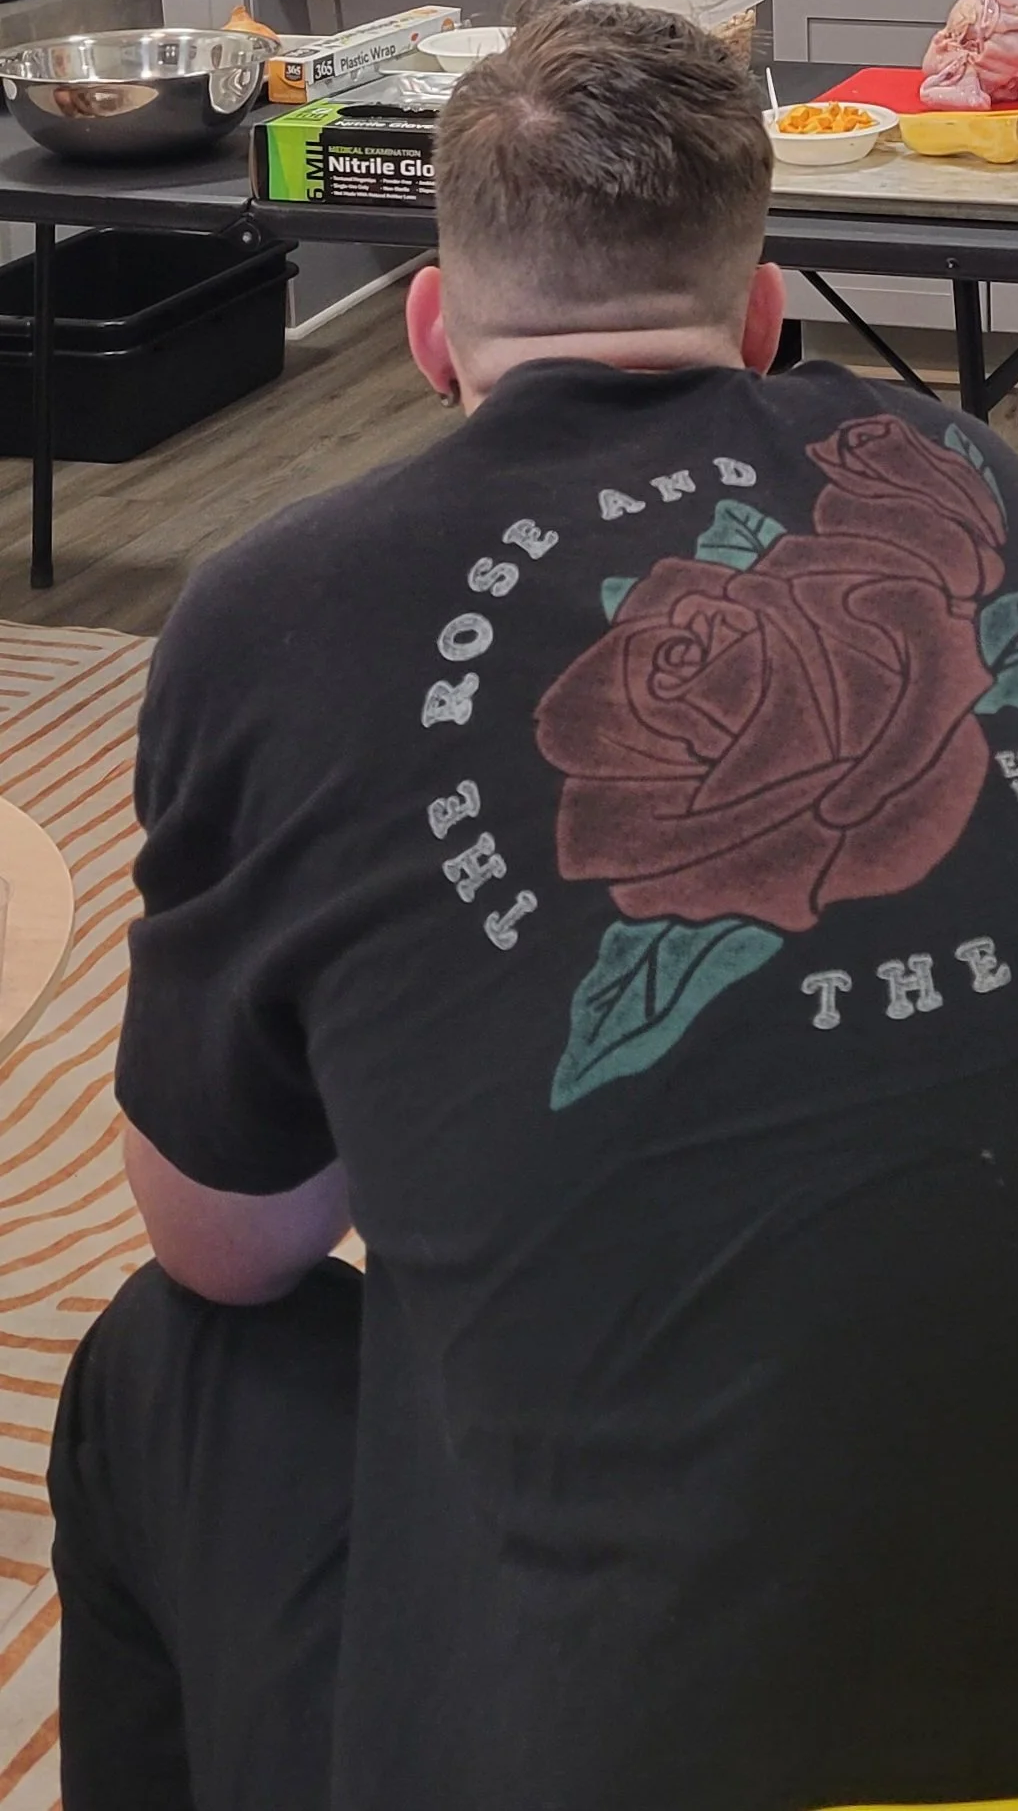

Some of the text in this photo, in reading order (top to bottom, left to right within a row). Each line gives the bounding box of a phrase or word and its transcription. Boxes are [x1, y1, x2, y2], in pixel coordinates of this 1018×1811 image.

[341, 45, 396, 70] Plastic Wrap
[286, 64, 301, 75] 365
[315, 59, 333, 79] 365
[388, 121, 434, 129] Glove
[328, 146, 421, 157] MEDICAL EXAMINATION
[305, 132, 324, 202] 6 MIL
[328, 155, 435, 177] Nitrile Glo
[421, 457, 757, 951] THE ROSE AND
[801, 936, 1011, 1030] THE
